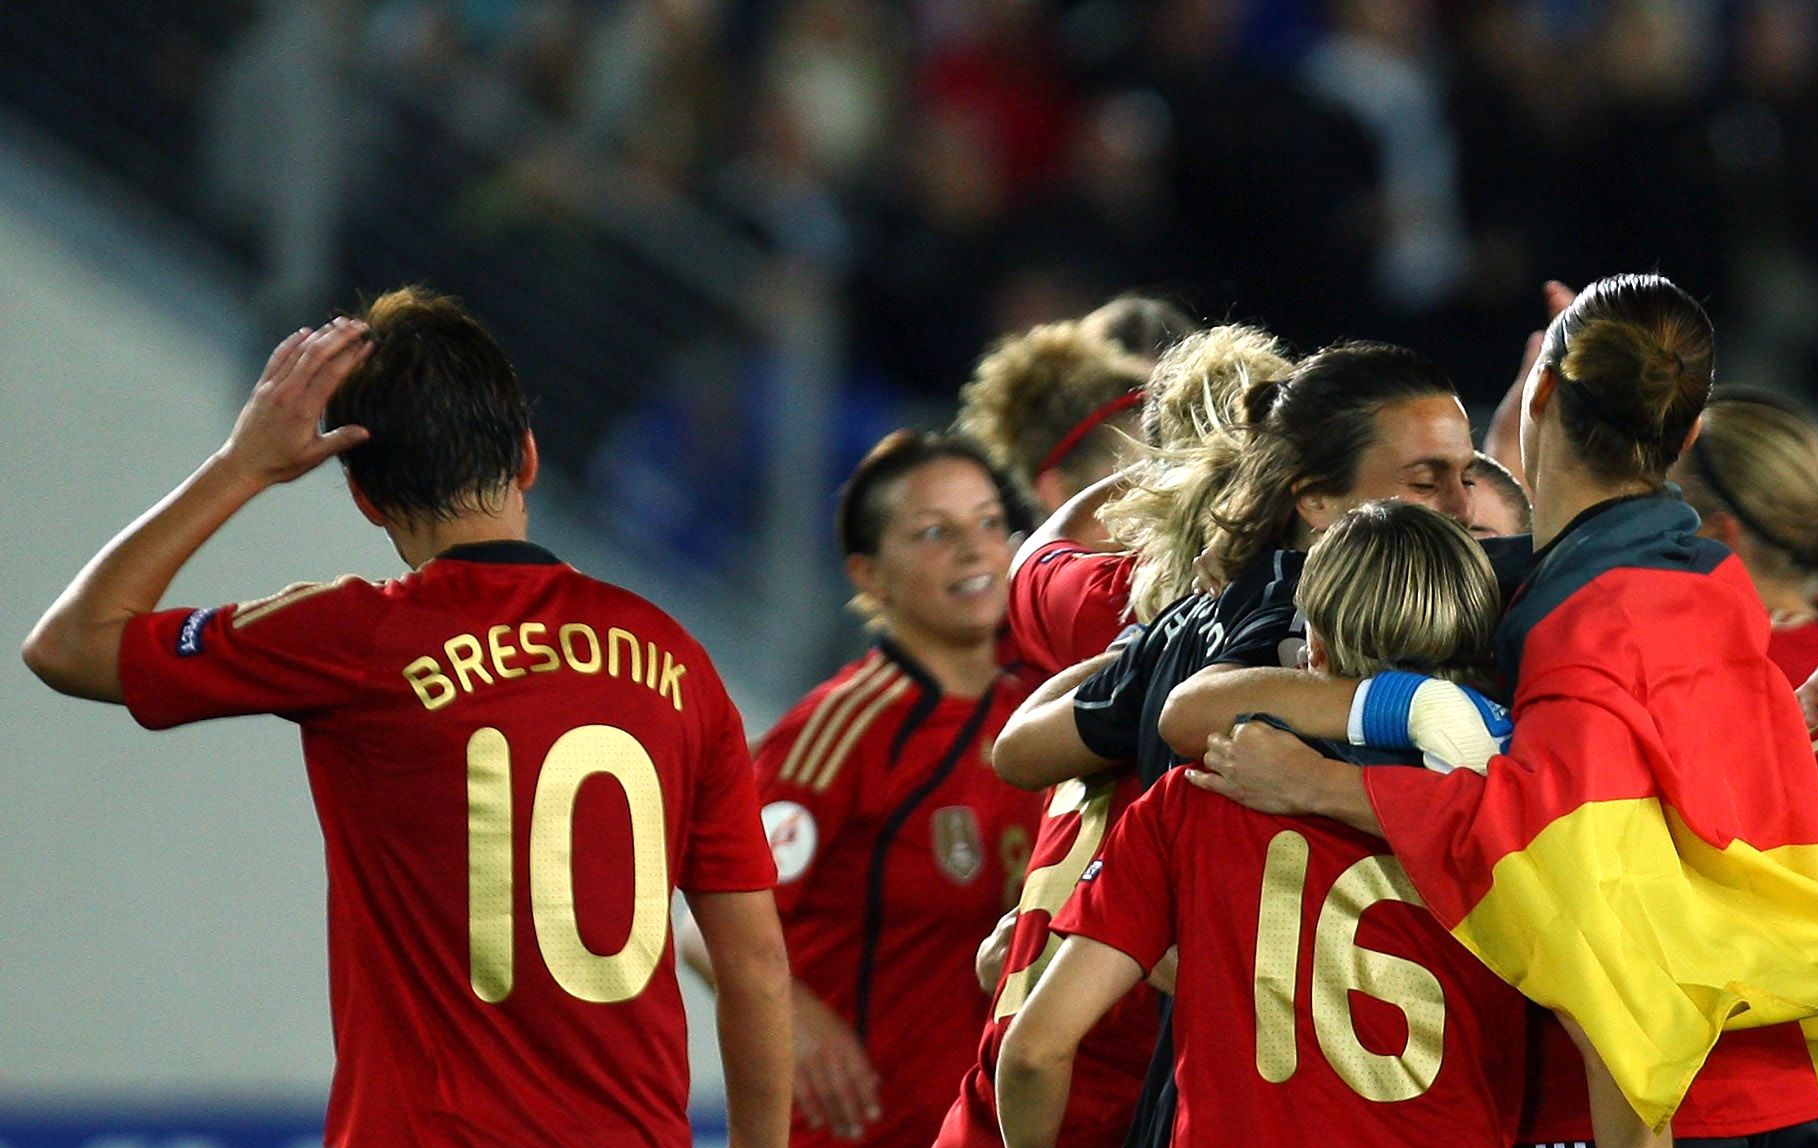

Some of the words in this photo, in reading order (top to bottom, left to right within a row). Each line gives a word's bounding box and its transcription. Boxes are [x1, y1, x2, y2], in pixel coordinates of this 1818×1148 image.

[402, 622, 687, 711] BRESONIK
[466, 725, 667, 1002] 10
[1255, 829, 1446, 1102] 16
